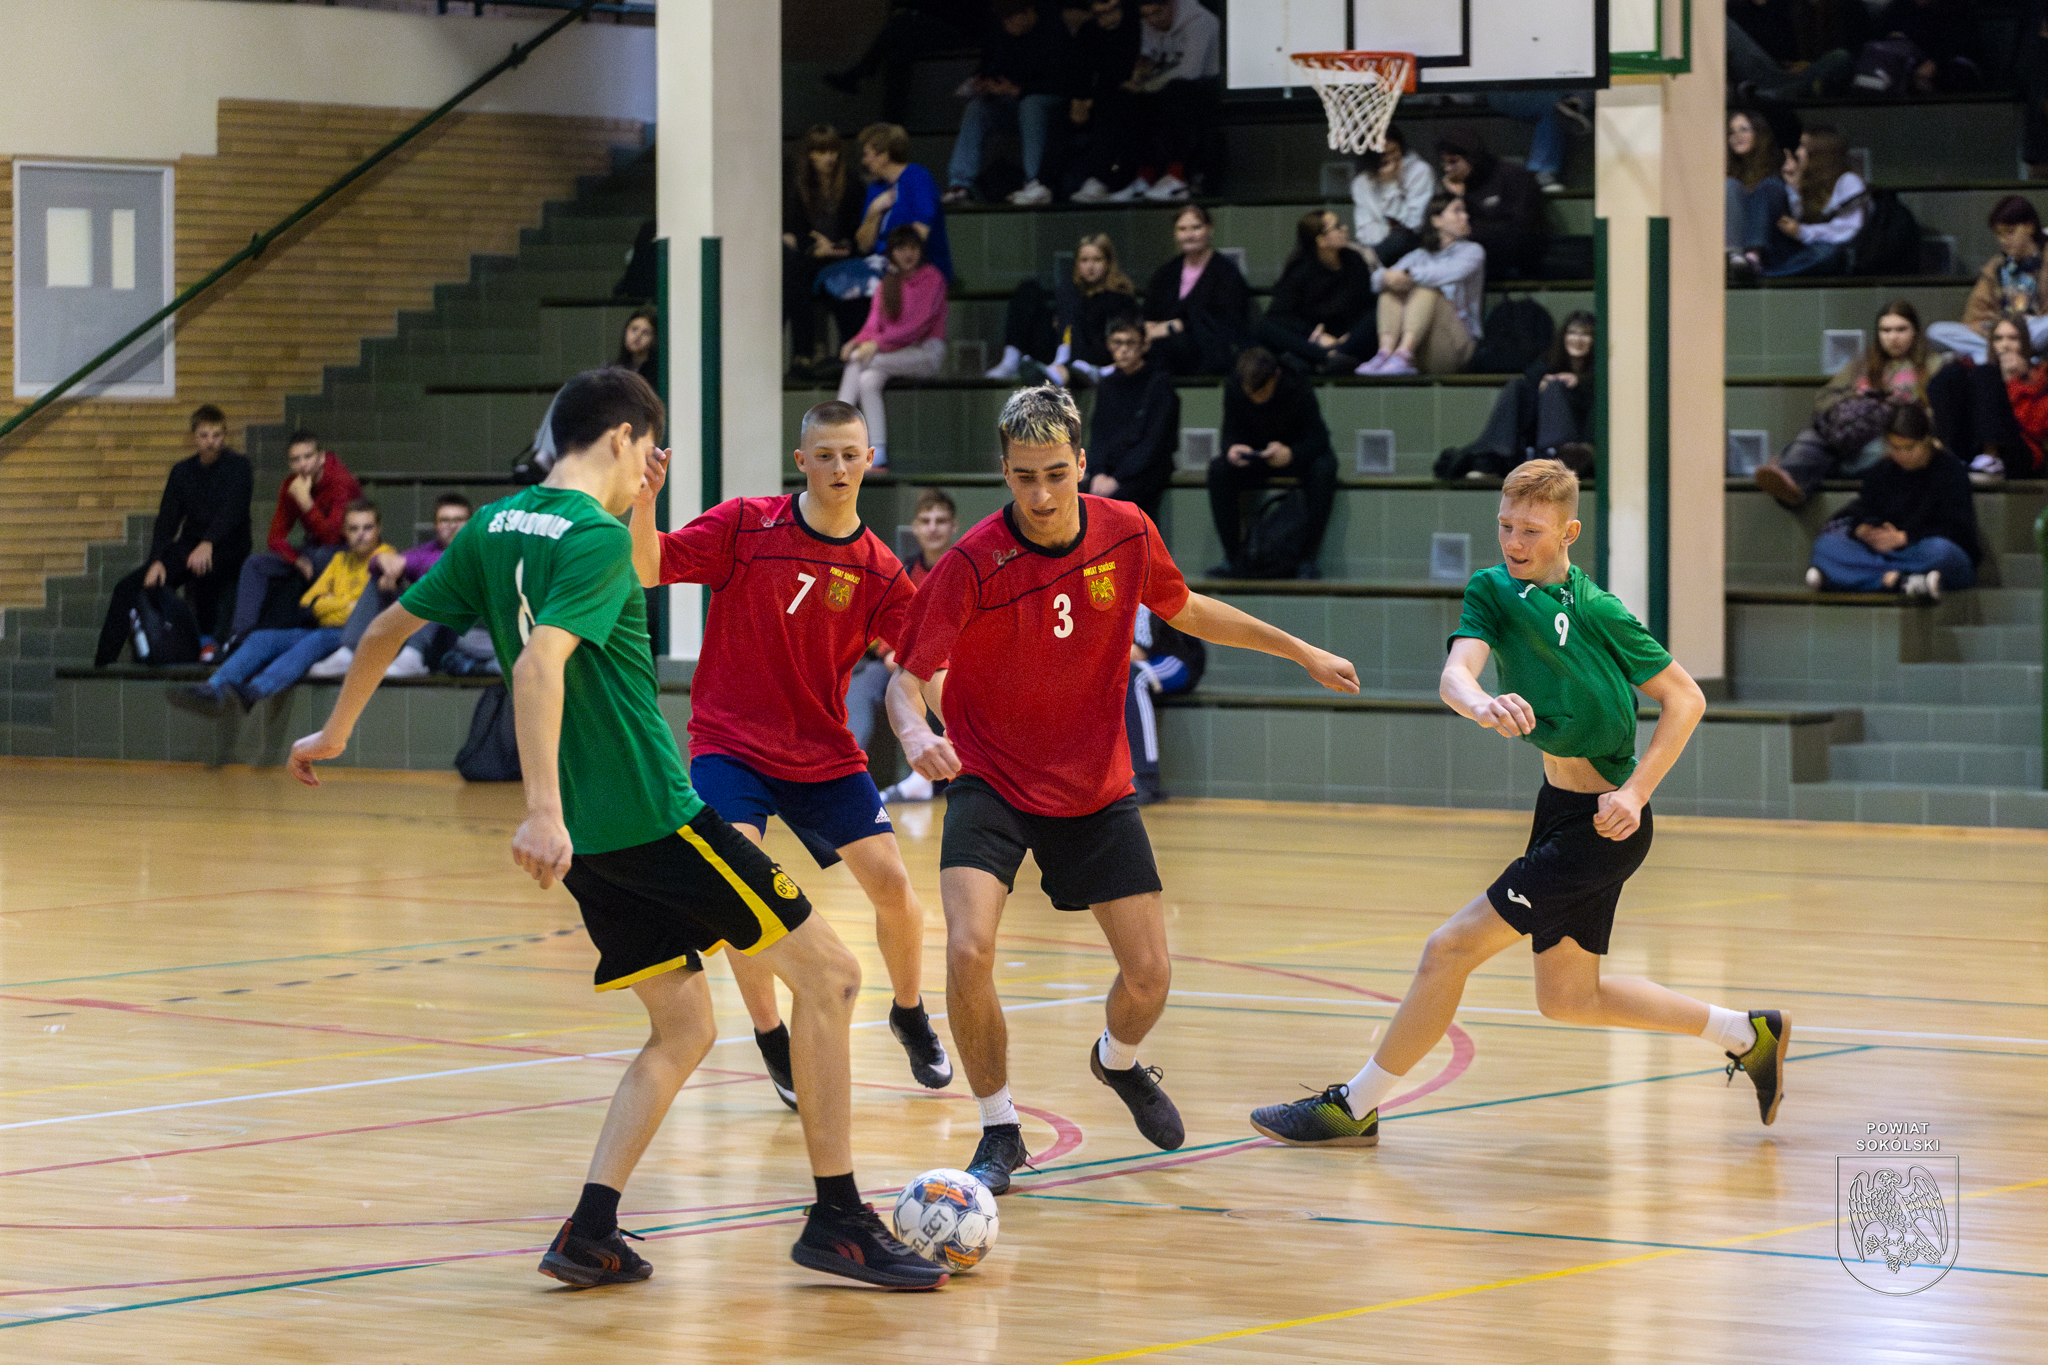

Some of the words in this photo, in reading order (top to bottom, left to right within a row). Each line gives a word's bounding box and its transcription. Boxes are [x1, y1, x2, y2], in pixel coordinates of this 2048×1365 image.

[786, 572, 817, 615] 7
[1053, 593, 1074, 639] 3
[1554, 612, 1570, 646] 9
[911, 1209, 949, 1252] ELECT
